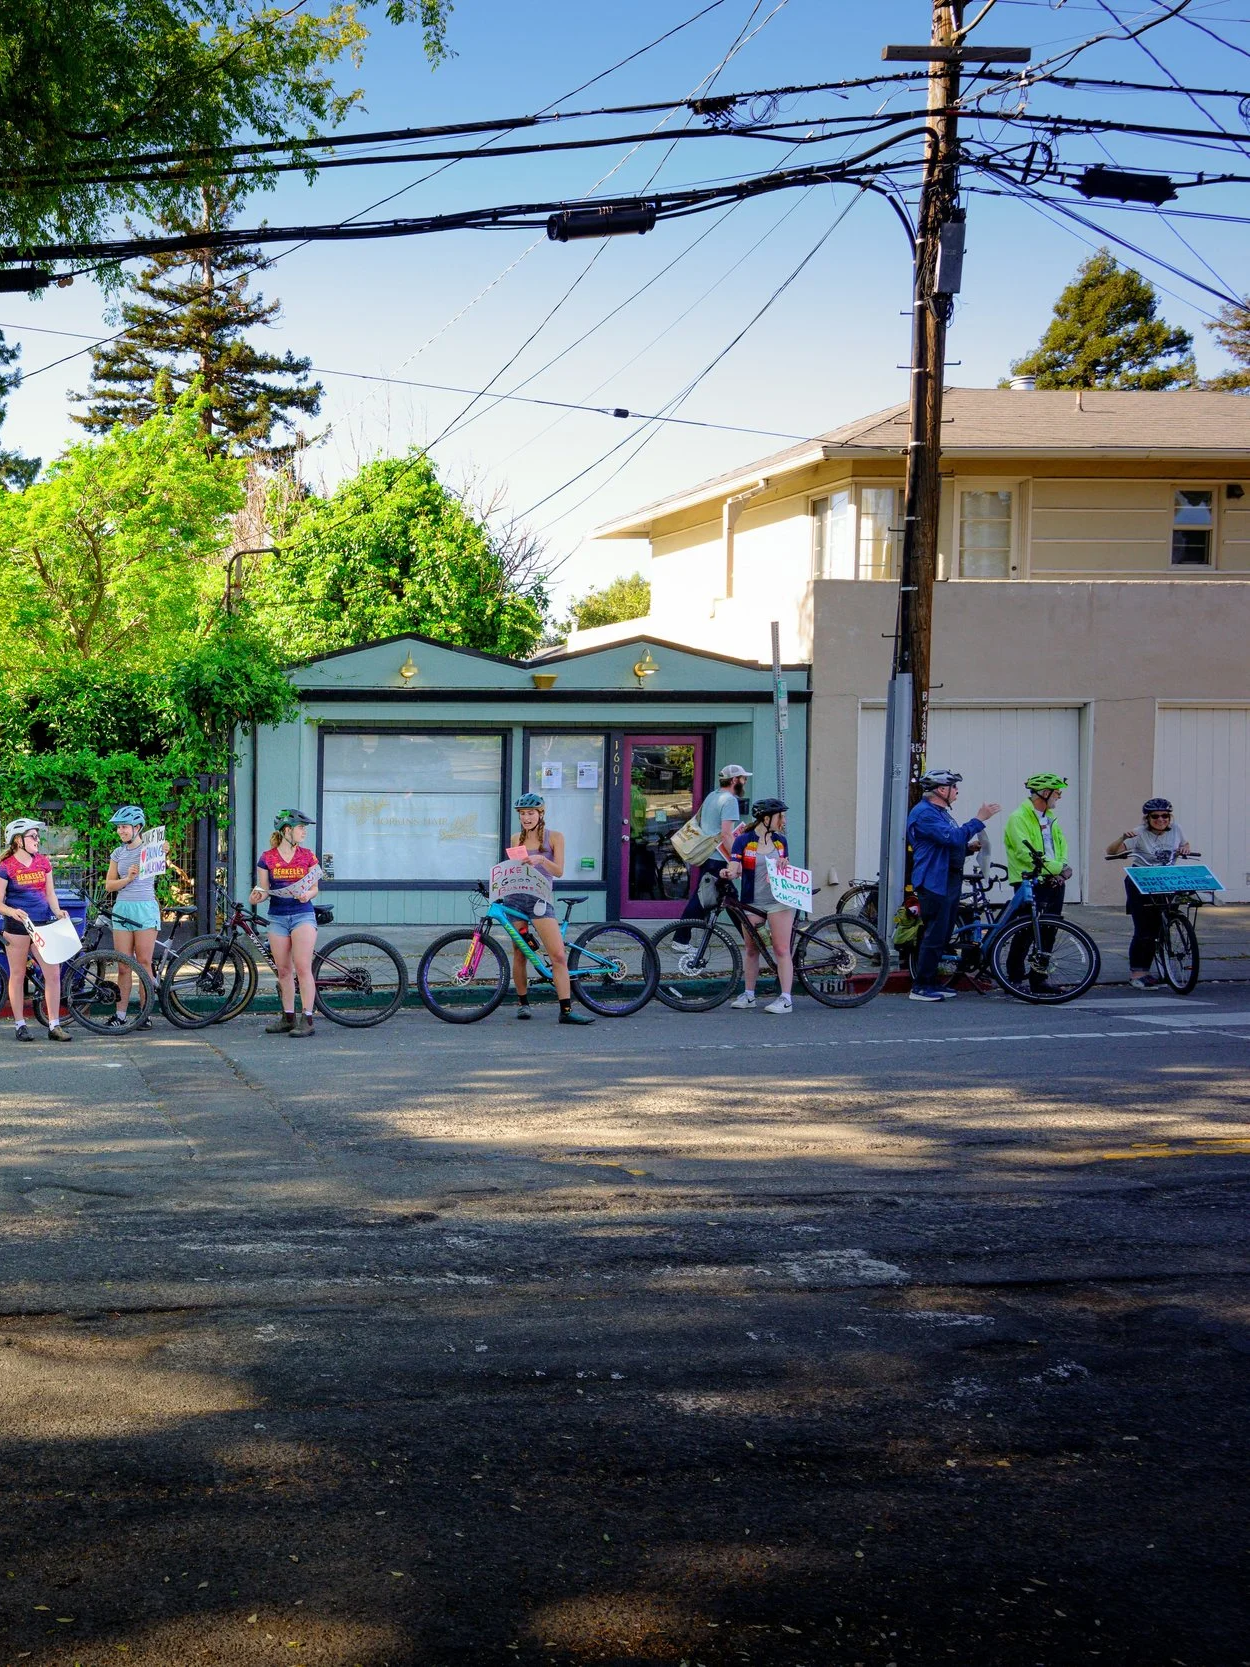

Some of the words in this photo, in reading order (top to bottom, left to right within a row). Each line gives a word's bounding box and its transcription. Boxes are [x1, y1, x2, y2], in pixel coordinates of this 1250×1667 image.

[613, 739, 621, 786] 1601
[273, 867, 305, 875] BERKELEY
[491, 866, 522, 883] BIKE
[776, 865, 810, 885] NEED
